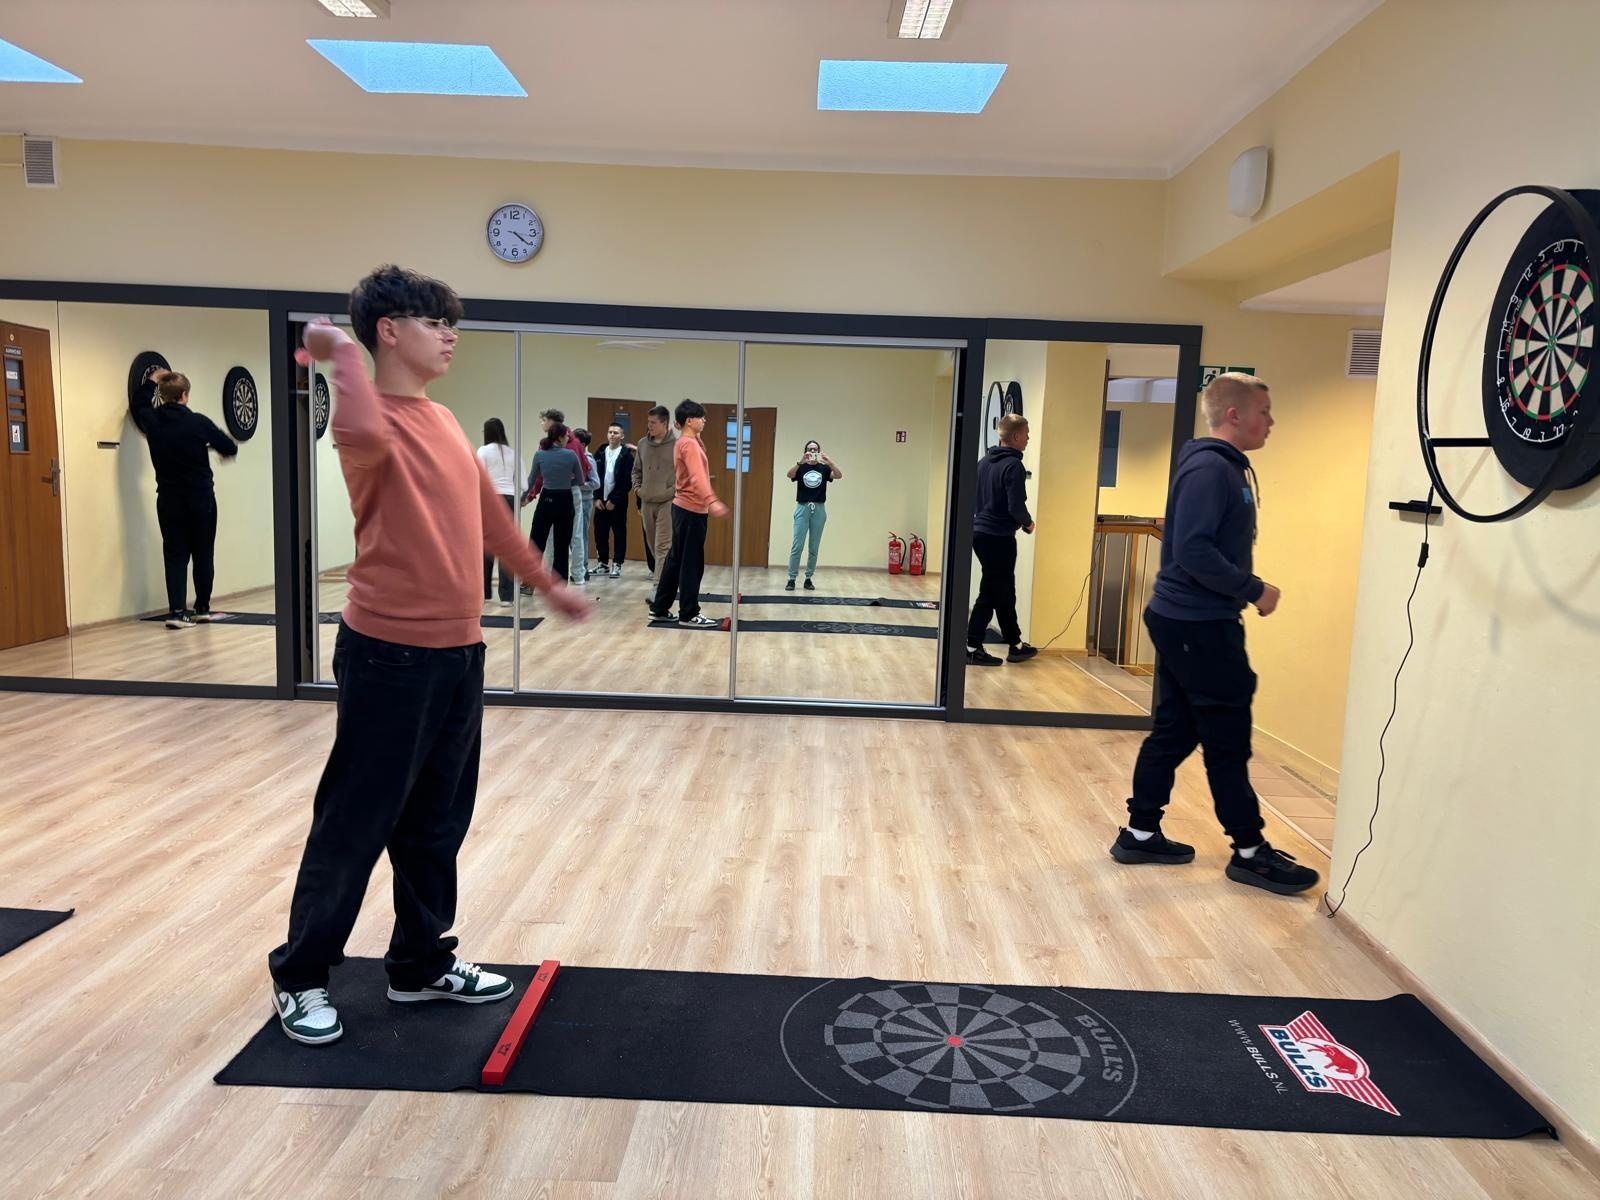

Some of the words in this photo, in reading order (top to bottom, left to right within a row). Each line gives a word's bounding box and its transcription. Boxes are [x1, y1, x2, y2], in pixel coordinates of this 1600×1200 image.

[510, 210, 520, 220] 12
[493, 228, 500, 237] 9
[529, 228, 537, 237] 3
[1553, 240, 1564, 253] 20
[511, 247, 519, 257] 6
[1511, 416, 1517, 427] 7
[1522, 427, 1532, 440] 19
[1267, 1028, 1328, 1089] BULL'S
